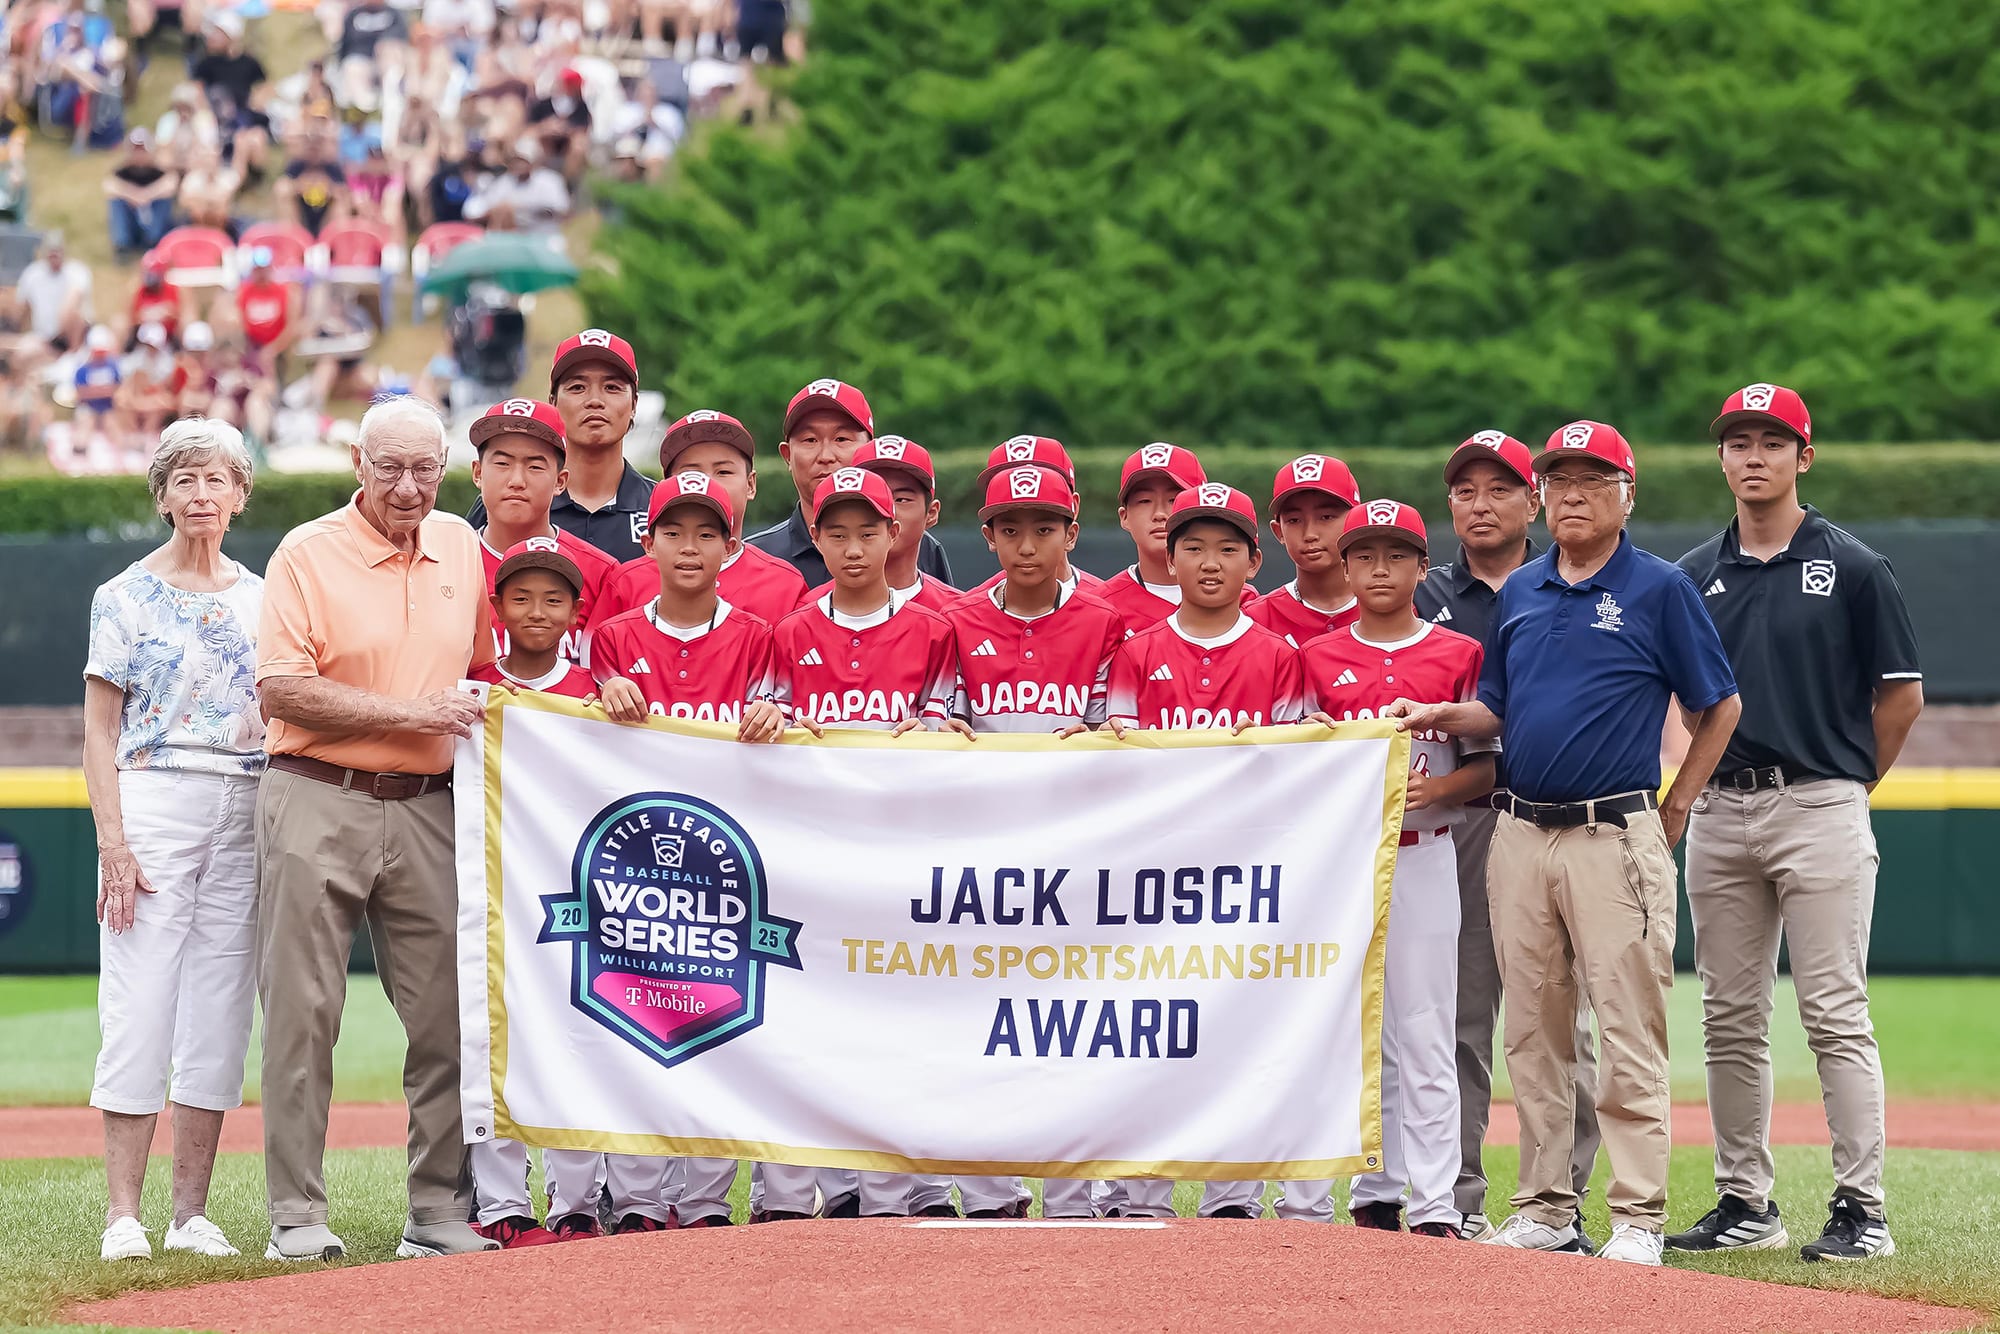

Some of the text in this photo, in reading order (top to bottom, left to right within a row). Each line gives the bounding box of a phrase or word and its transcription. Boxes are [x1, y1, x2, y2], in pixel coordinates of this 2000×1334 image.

[649, 700, 740, 723] PAN
[794, 689, 916, 723] JAPAN
[970, 681, 1090, 717] JAPAN
[600, 812, 738, 889] LITTLE LEAGUE
[625, 866, 713, 886] BASEBALL
[593, 878, 746, 924] WORLD
[910, 865, 1282, 926] JACK LOSCH
[561, 908, 581, 927] 20
[599, 916, 738, 961] SERIES
[758, 927, 779, 948] 25
[599, 953, 735, 979] WILLIAMSPORT
[841, 938, 1342, 980] TEAM SPORTSMANSHIP
[639, 978, 679, 990] PRESENTED
[646, 989, 706, 1015] Mobile
[983, 997, 1199, 1059] AWARD
